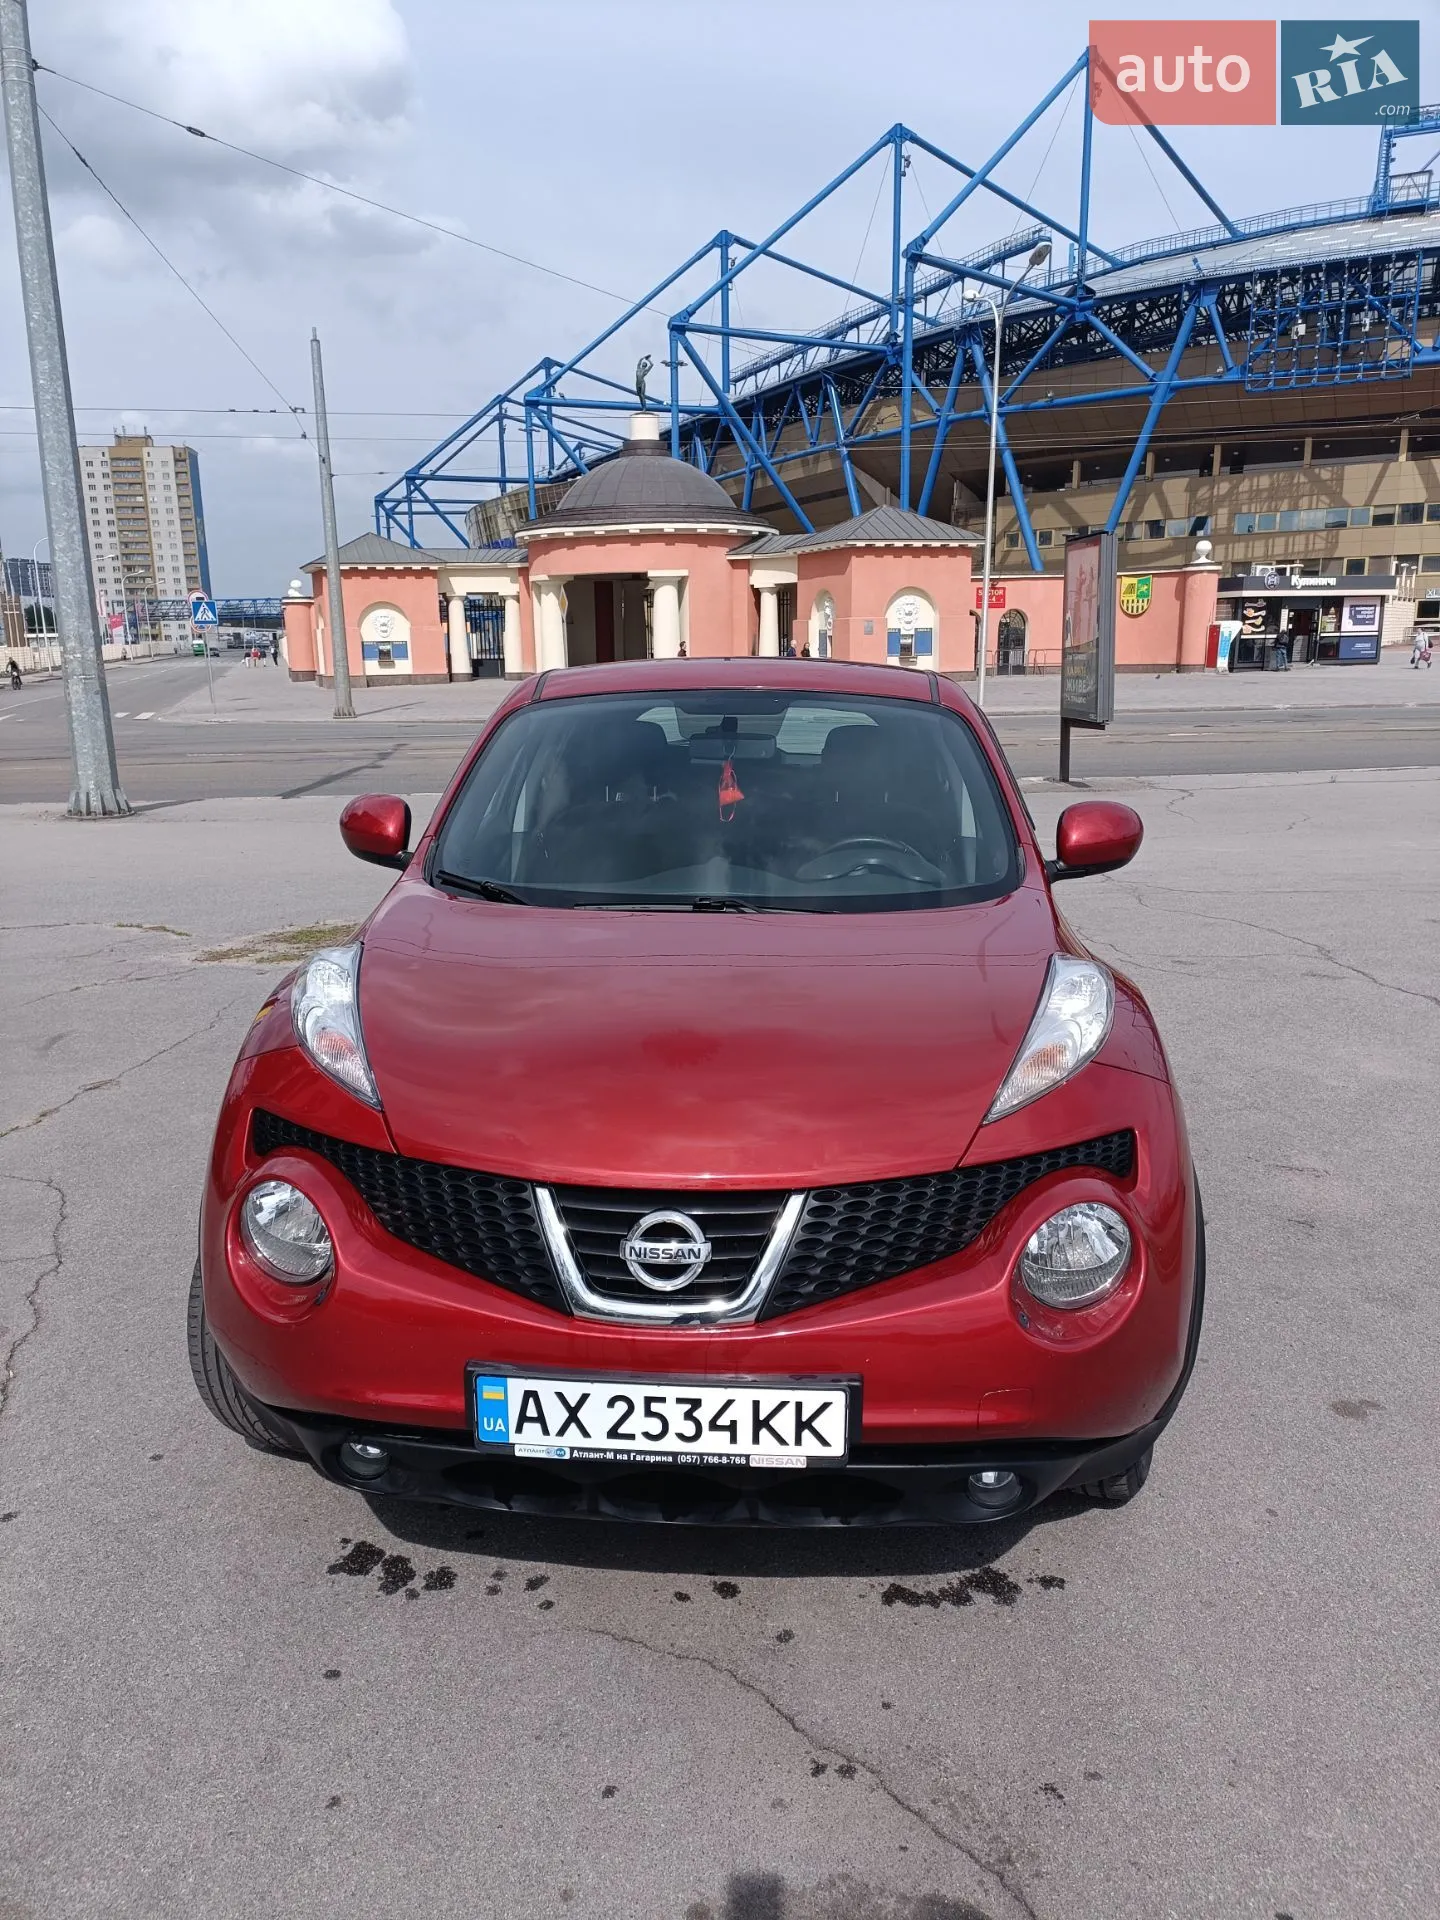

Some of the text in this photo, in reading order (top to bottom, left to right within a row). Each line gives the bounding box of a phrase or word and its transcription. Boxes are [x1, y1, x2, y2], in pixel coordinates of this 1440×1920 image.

[978, 589, 1004, 597] SCTOR
[629, 1245, 701, 1260] NISSAN
[483, 1417, 507, 1433] UA
[572, 1449, 747, 1465] Атлант-М на Гагарина (057) 766-8-766
[750, 1457, 806, 1467] NISSAN
